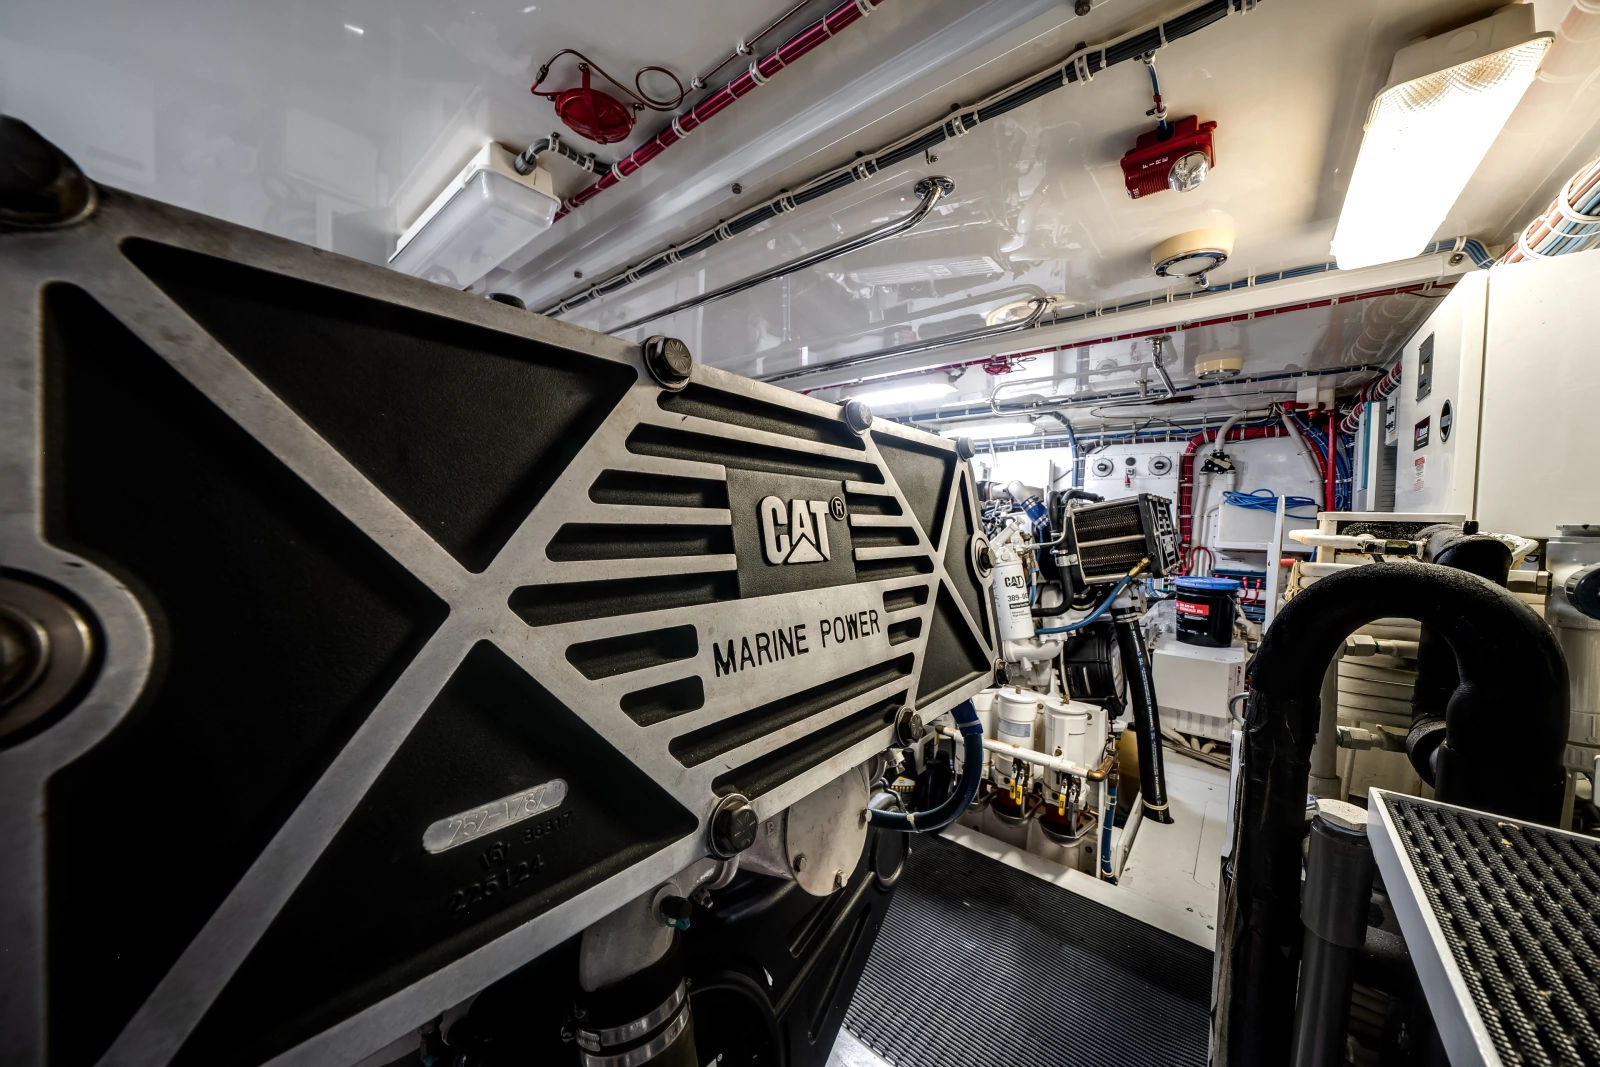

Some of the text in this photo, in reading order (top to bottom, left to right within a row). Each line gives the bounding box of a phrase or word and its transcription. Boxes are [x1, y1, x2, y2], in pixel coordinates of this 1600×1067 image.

[1142, 156, 1169, 169] FIRE
[1004, 575, 1024, 588] CAT
[712, 609, 881, 678] MARINE POWER
